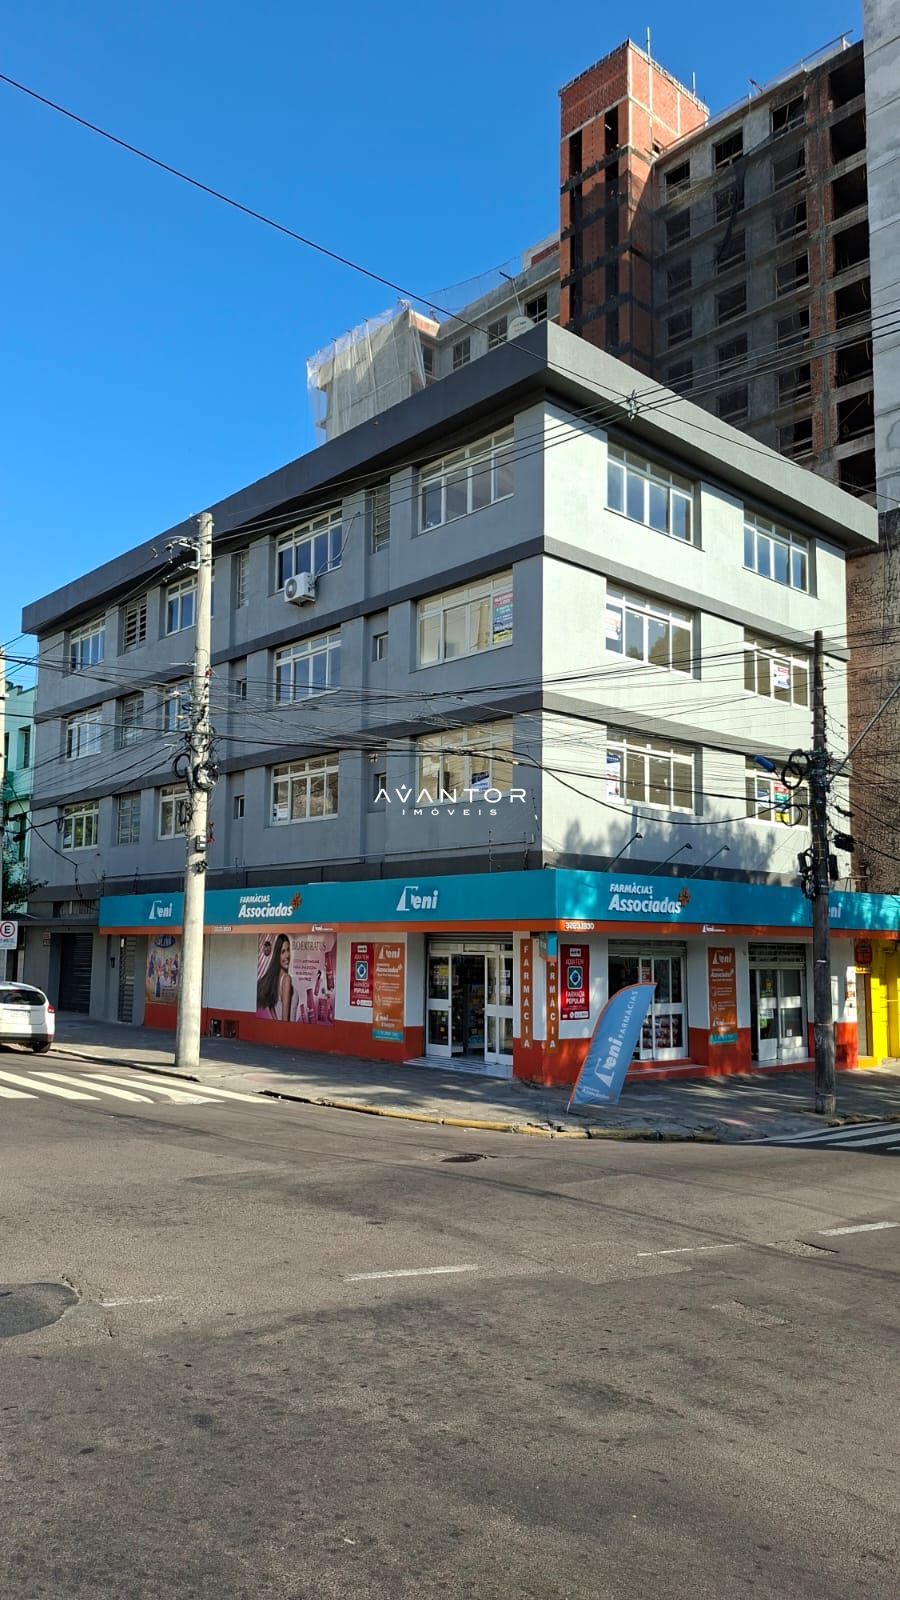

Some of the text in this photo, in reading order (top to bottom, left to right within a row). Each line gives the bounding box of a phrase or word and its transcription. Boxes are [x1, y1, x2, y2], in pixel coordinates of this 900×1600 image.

[238, 902, 294, 918] Associadas
[608, 894, 682, 914] Associadas
[4, 925, 11, 934] E
